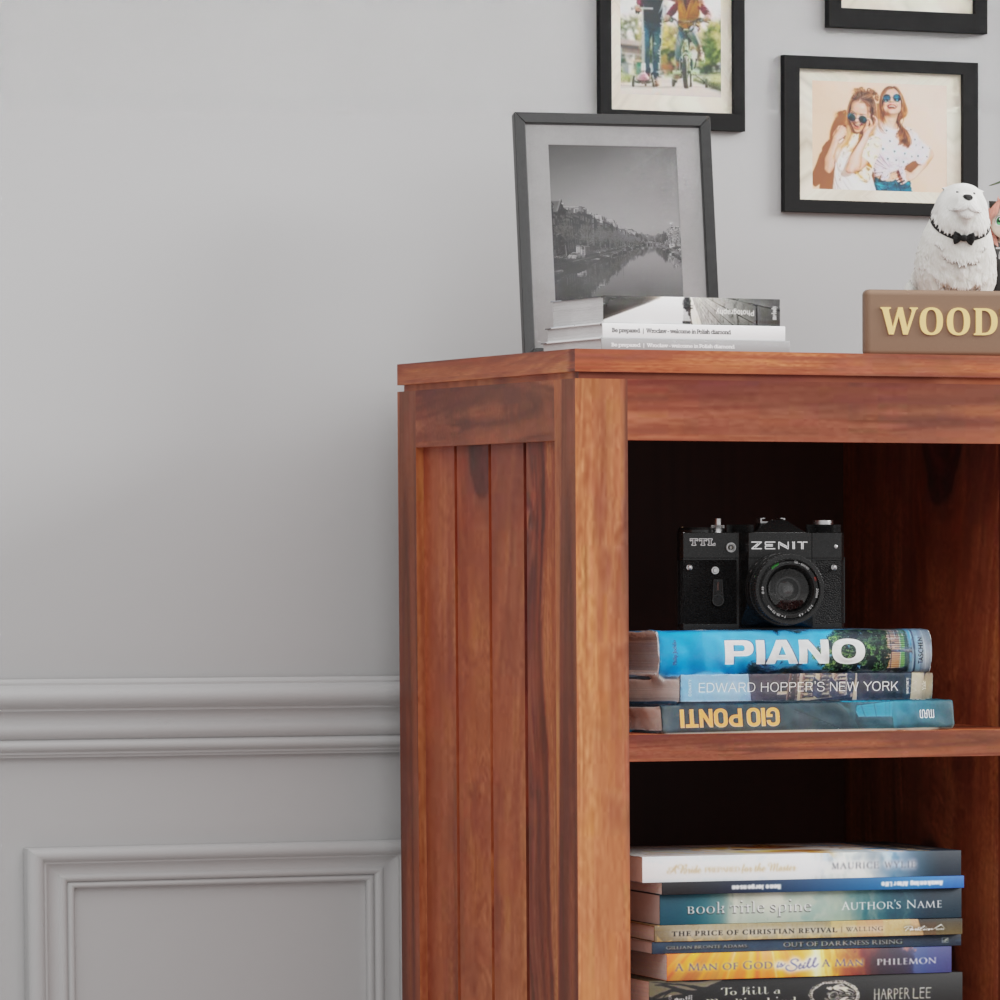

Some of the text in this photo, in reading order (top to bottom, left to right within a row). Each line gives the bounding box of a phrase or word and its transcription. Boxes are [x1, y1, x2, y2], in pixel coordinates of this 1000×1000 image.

[716, 308, 755, 316] Photography
[689, 538, 716, 546] TTL
[751, 541, 808, 550] ZENIT
[724, 638, 866, 665] PIANO
[698, 680, 899, 692] EDWARD HOPPER'S NEW YORK
[680, 707, 780, 728] GIO PONTI
[679, 863, 797, 873] Bride for the Master
[831, 861, 880, 870] MAURICE
[841, 899, 942, 910] AUTHOR'S NAME
[675, 963, 683, 971] A
[688, 963, 718, 971] MAN
[743, 961, 773, 969] GOD
[785, 958, 818, 972] Still
[822, 959, 830, 967] A
[835, 959, 864, 967] MAN
[877, 957, 937, 966] PHILEMON
[720, 987, 737, 996] To
[741, 986, 769, 995] Kill
[873, 987, 932, 1000] HARPER LEE
